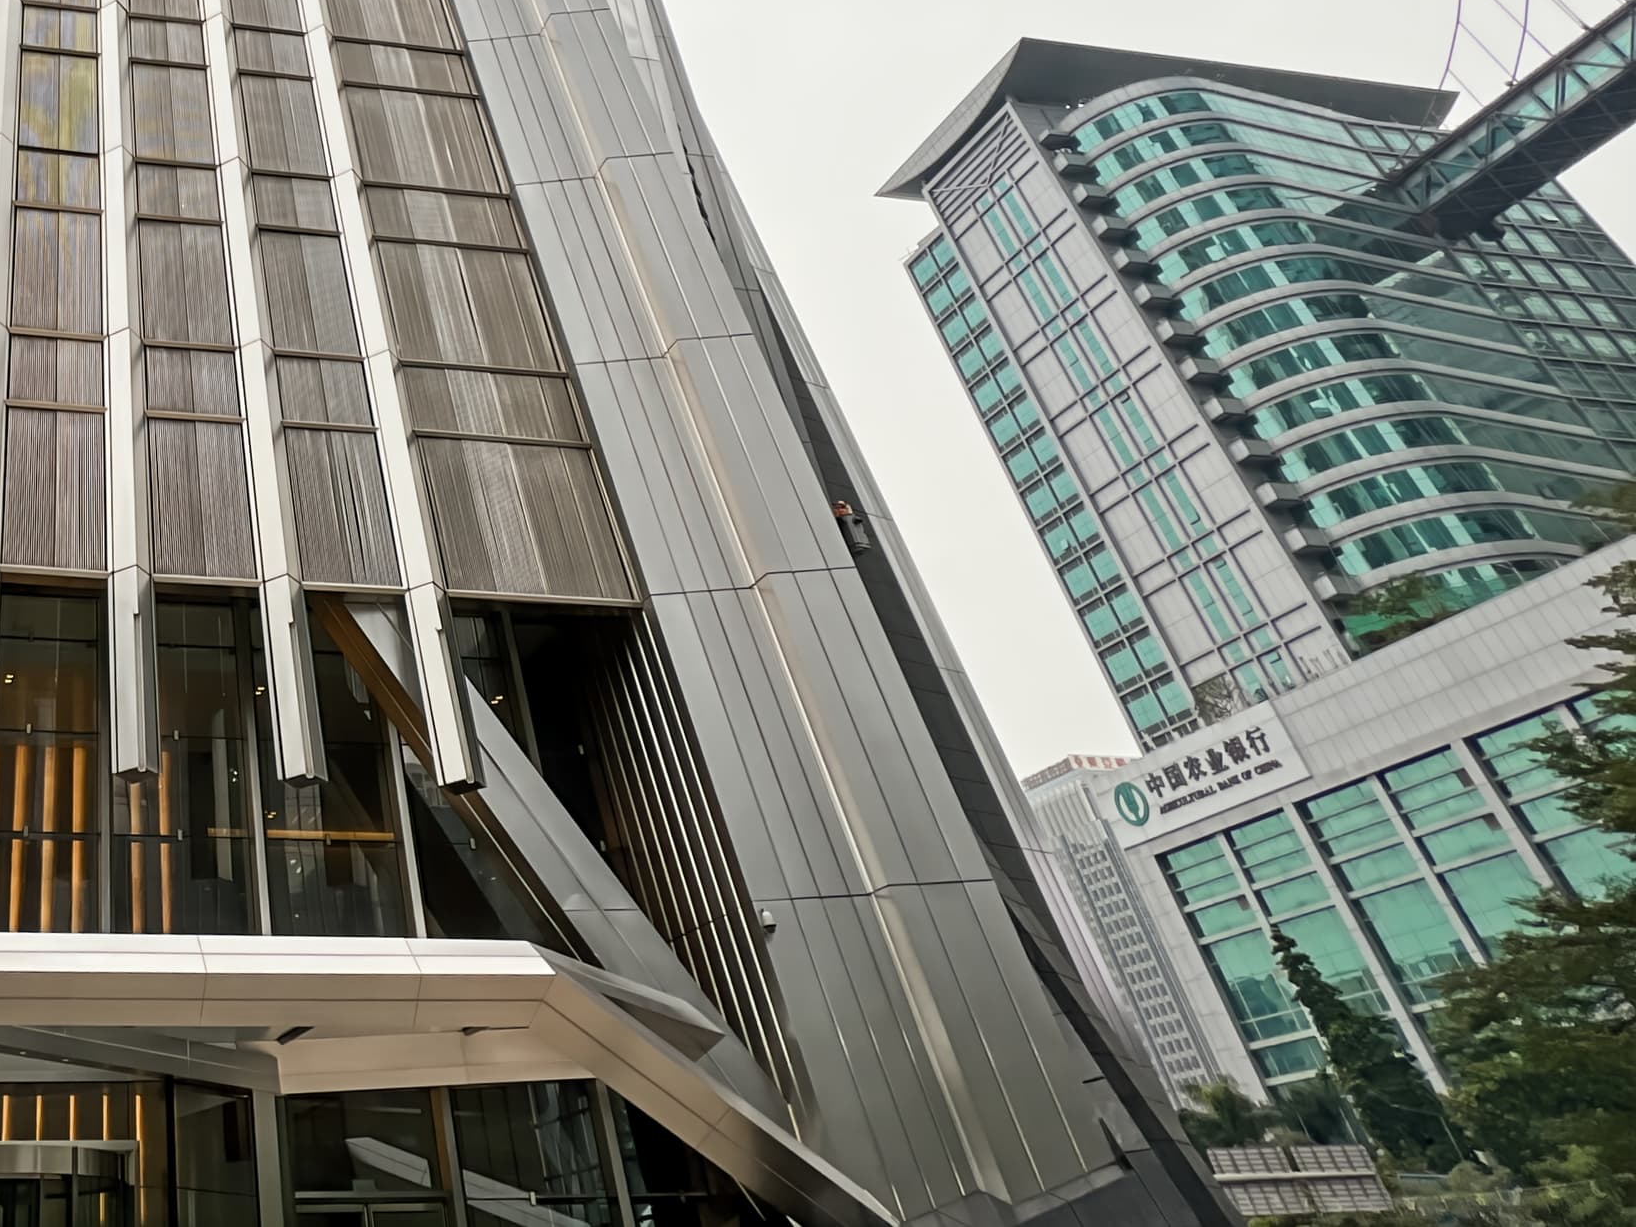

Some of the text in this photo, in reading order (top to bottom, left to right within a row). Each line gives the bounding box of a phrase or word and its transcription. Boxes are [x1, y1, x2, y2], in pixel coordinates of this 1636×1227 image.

[1145, 726, 1270, 798] 中国农业银行
